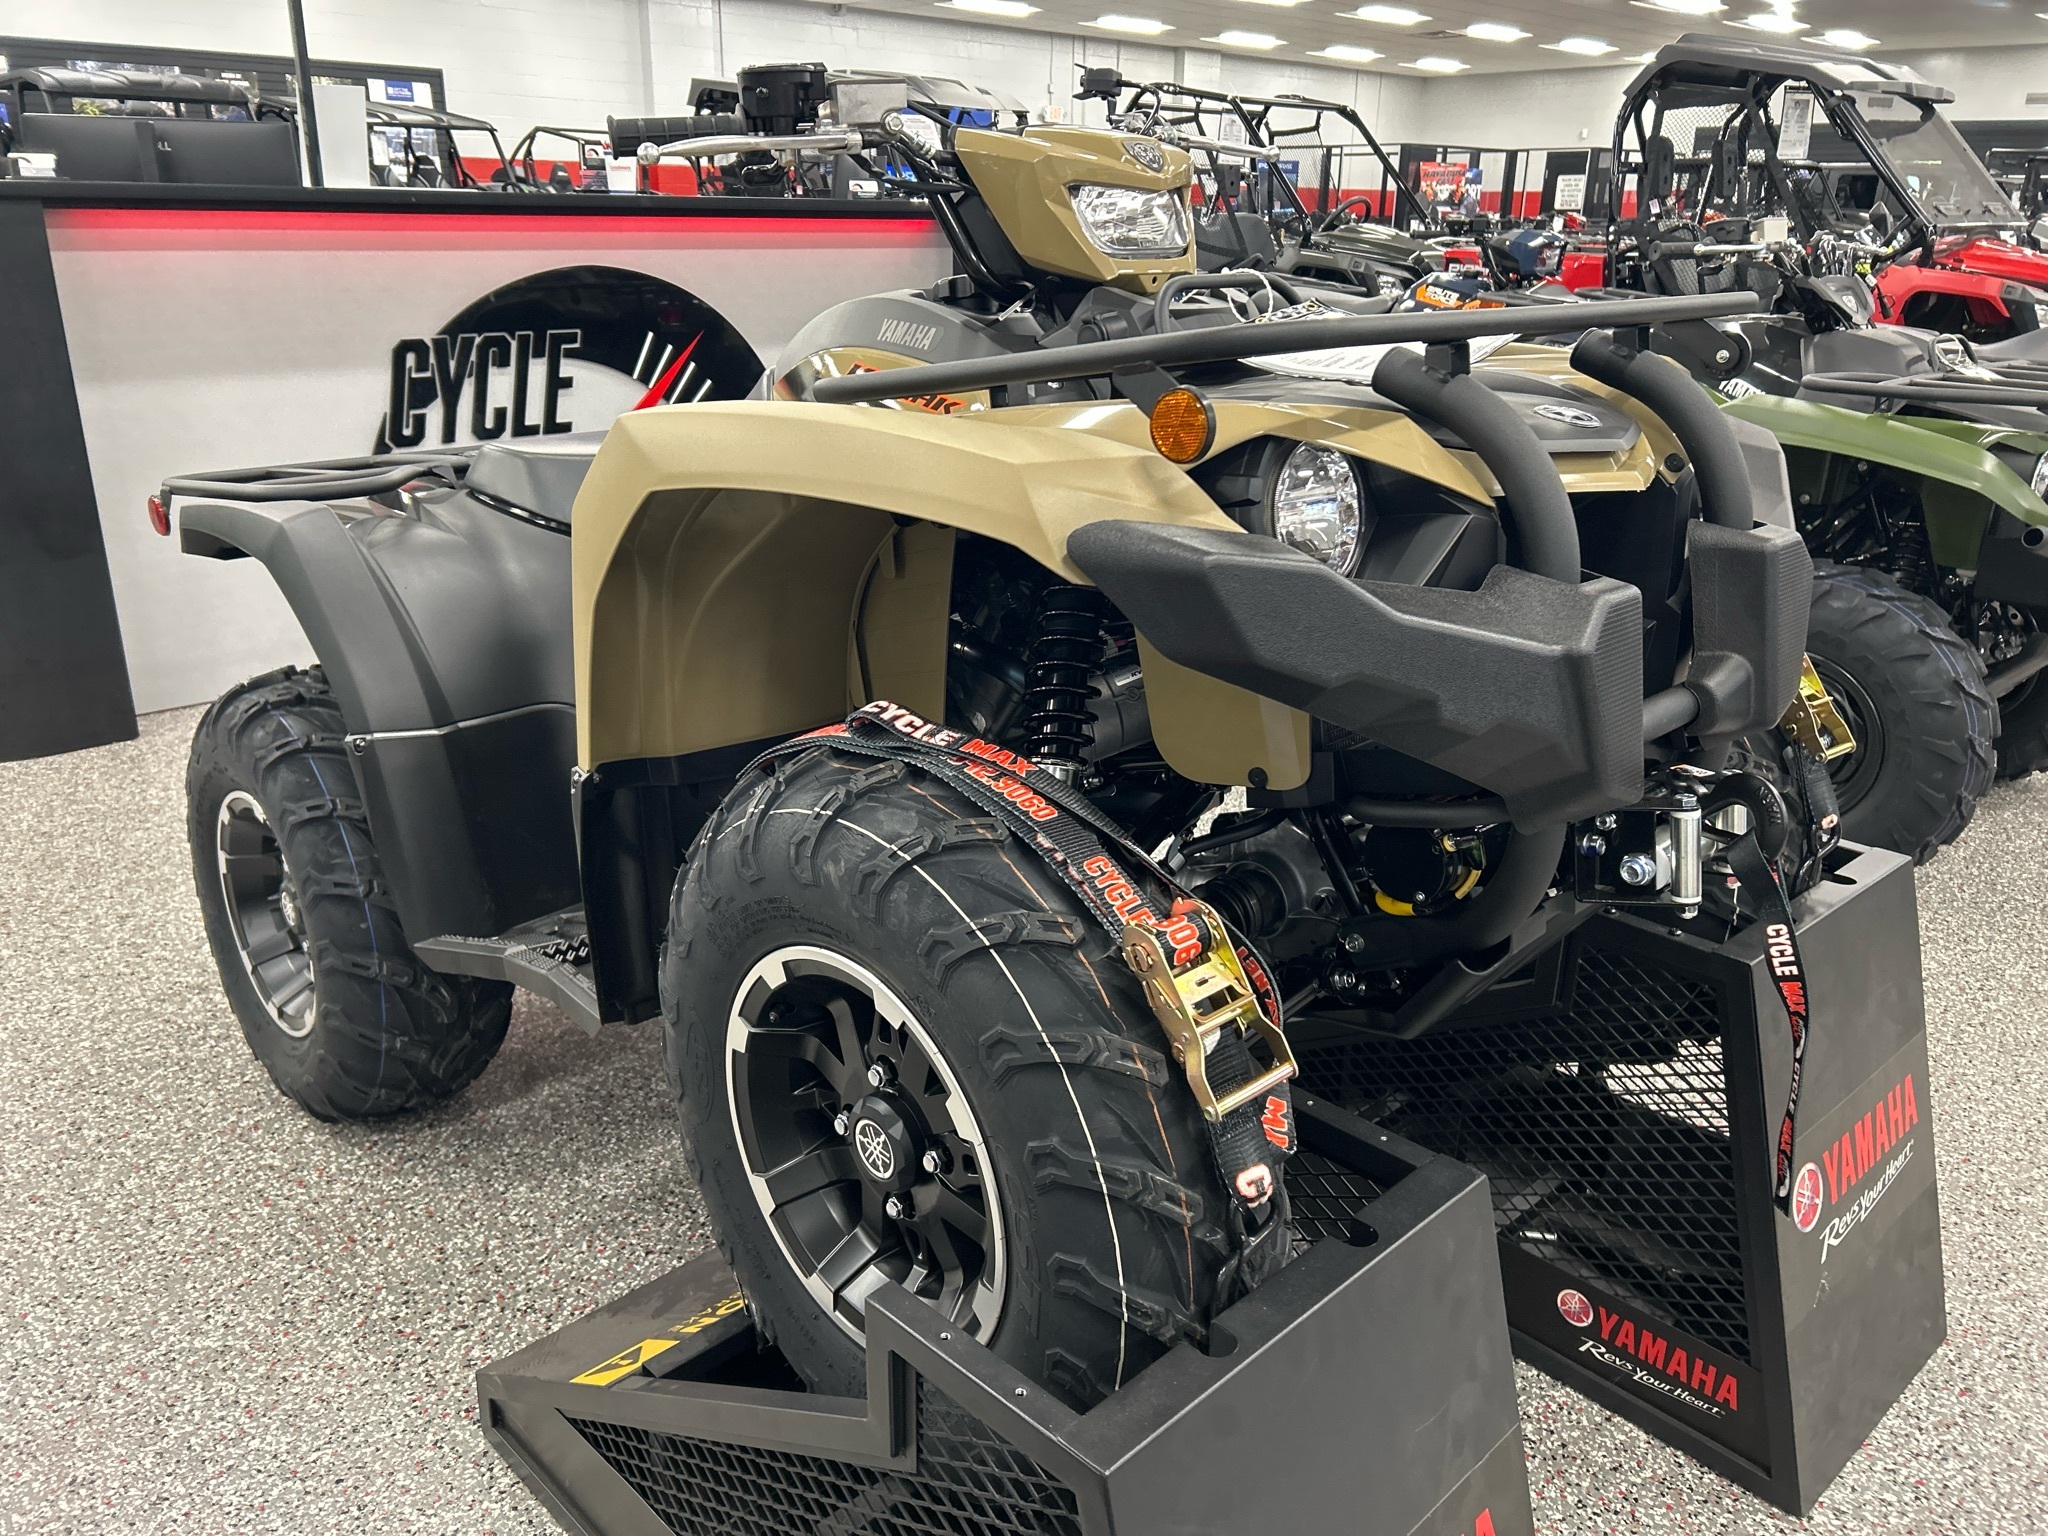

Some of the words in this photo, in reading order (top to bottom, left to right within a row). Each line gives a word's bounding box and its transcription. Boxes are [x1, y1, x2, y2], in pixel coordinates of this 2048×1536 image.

[1424, 292, 1459, 307] FORCE
[1425, 284, 1460, 300] BRUTE
[877, 318, 937, 351] YAMAHA
[388, 328, 582, 448] CYCLE
[860, 699, 963, 748] CYCLE
[958, 737, 1040, 778] MAX
[1083, 854, 1156, 927] CYCLE
[1766, 923, 1799, 977] CYCLE
[1779, 981, 1806, 1017] MAX
[1787, 1061, 1802, 1115] CYCLE
[1779, 1115, 1794, 1157] MAX
[1821, 1072, 1919, 1206] YAMAHA
[1818, 1198, 1861, 1265] Revs
[1858, 1172, 1889, 1223] Your
[1884, 1141, 1913, 1185] Heart
[1577, 1336, 1633, 1372] Revs
[1631, 1365, 1676, 1394] Your
[1673, 1386, 1722, 1416] Heart
[1598, 1305, 1739, 1412] YAMAHA
